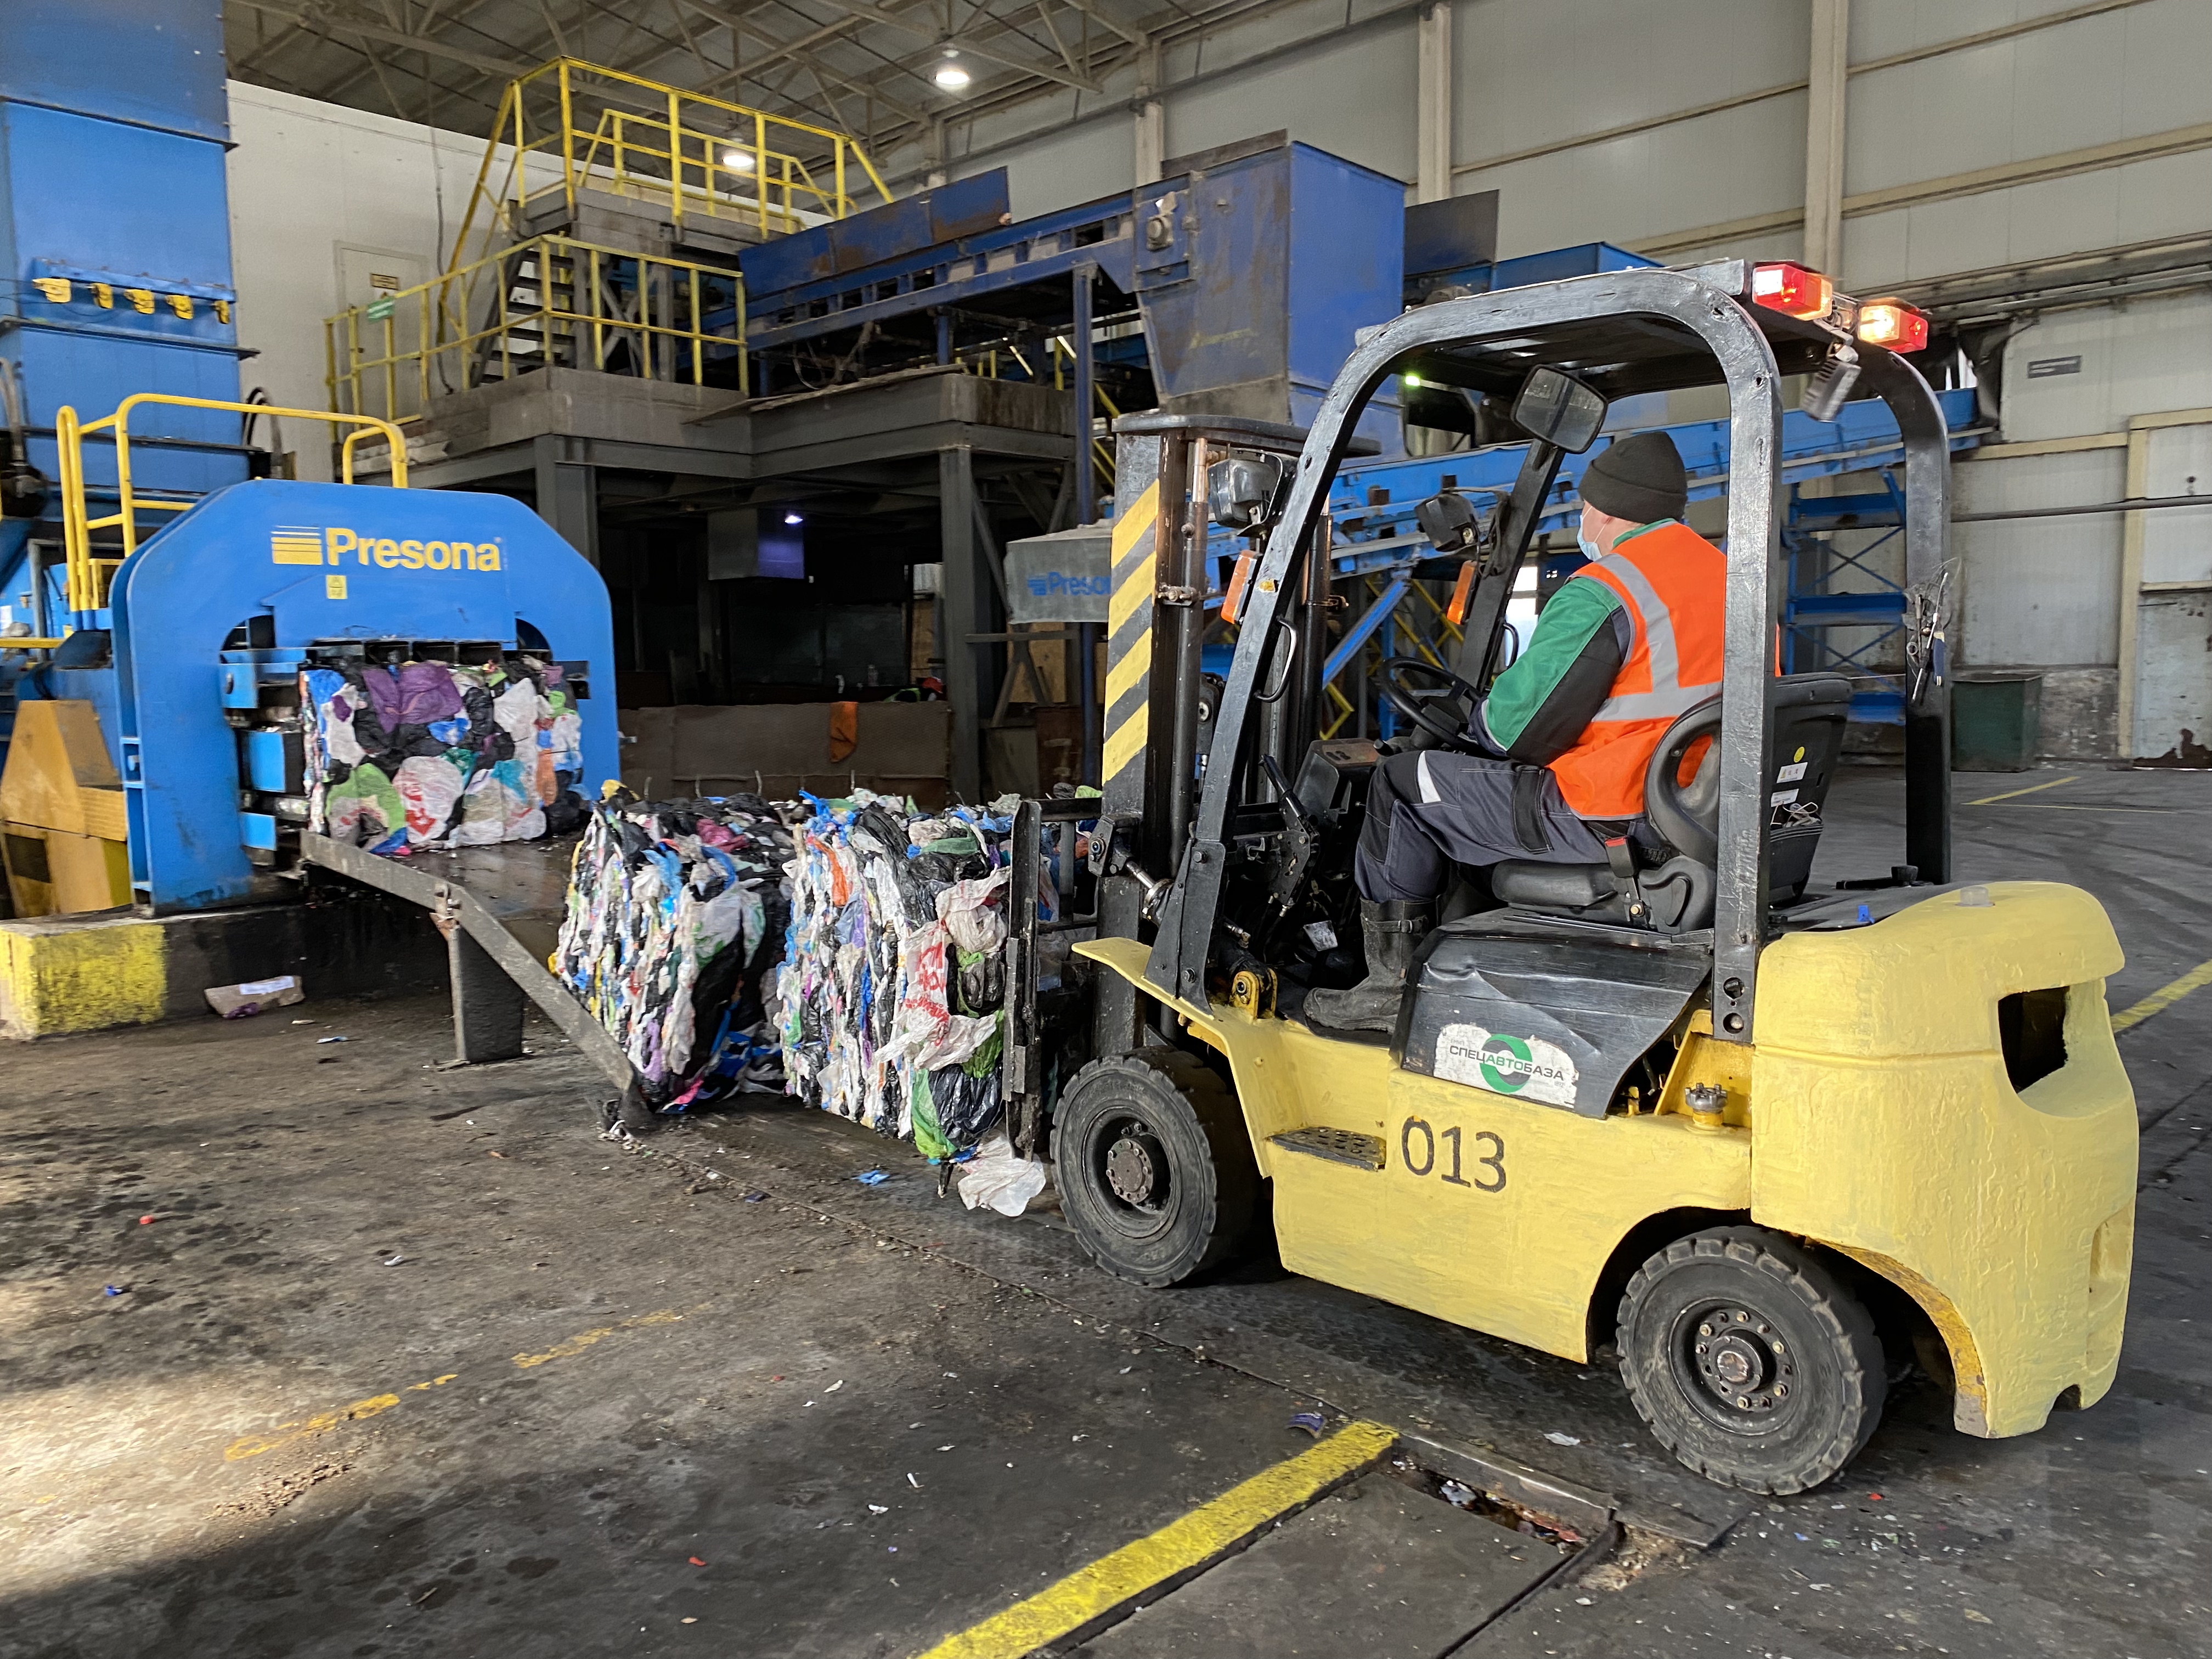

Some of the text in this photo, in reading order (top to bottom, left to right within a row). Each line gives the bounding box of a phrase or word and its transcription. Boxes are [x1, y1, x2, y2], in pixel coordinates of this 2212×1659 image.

[325, 527, 501, 572] Presona
[1449, 1045, 1564, 1081] СПЕЦАВТОБАЗА
[1401, 1115, 1506, 1193] 013
